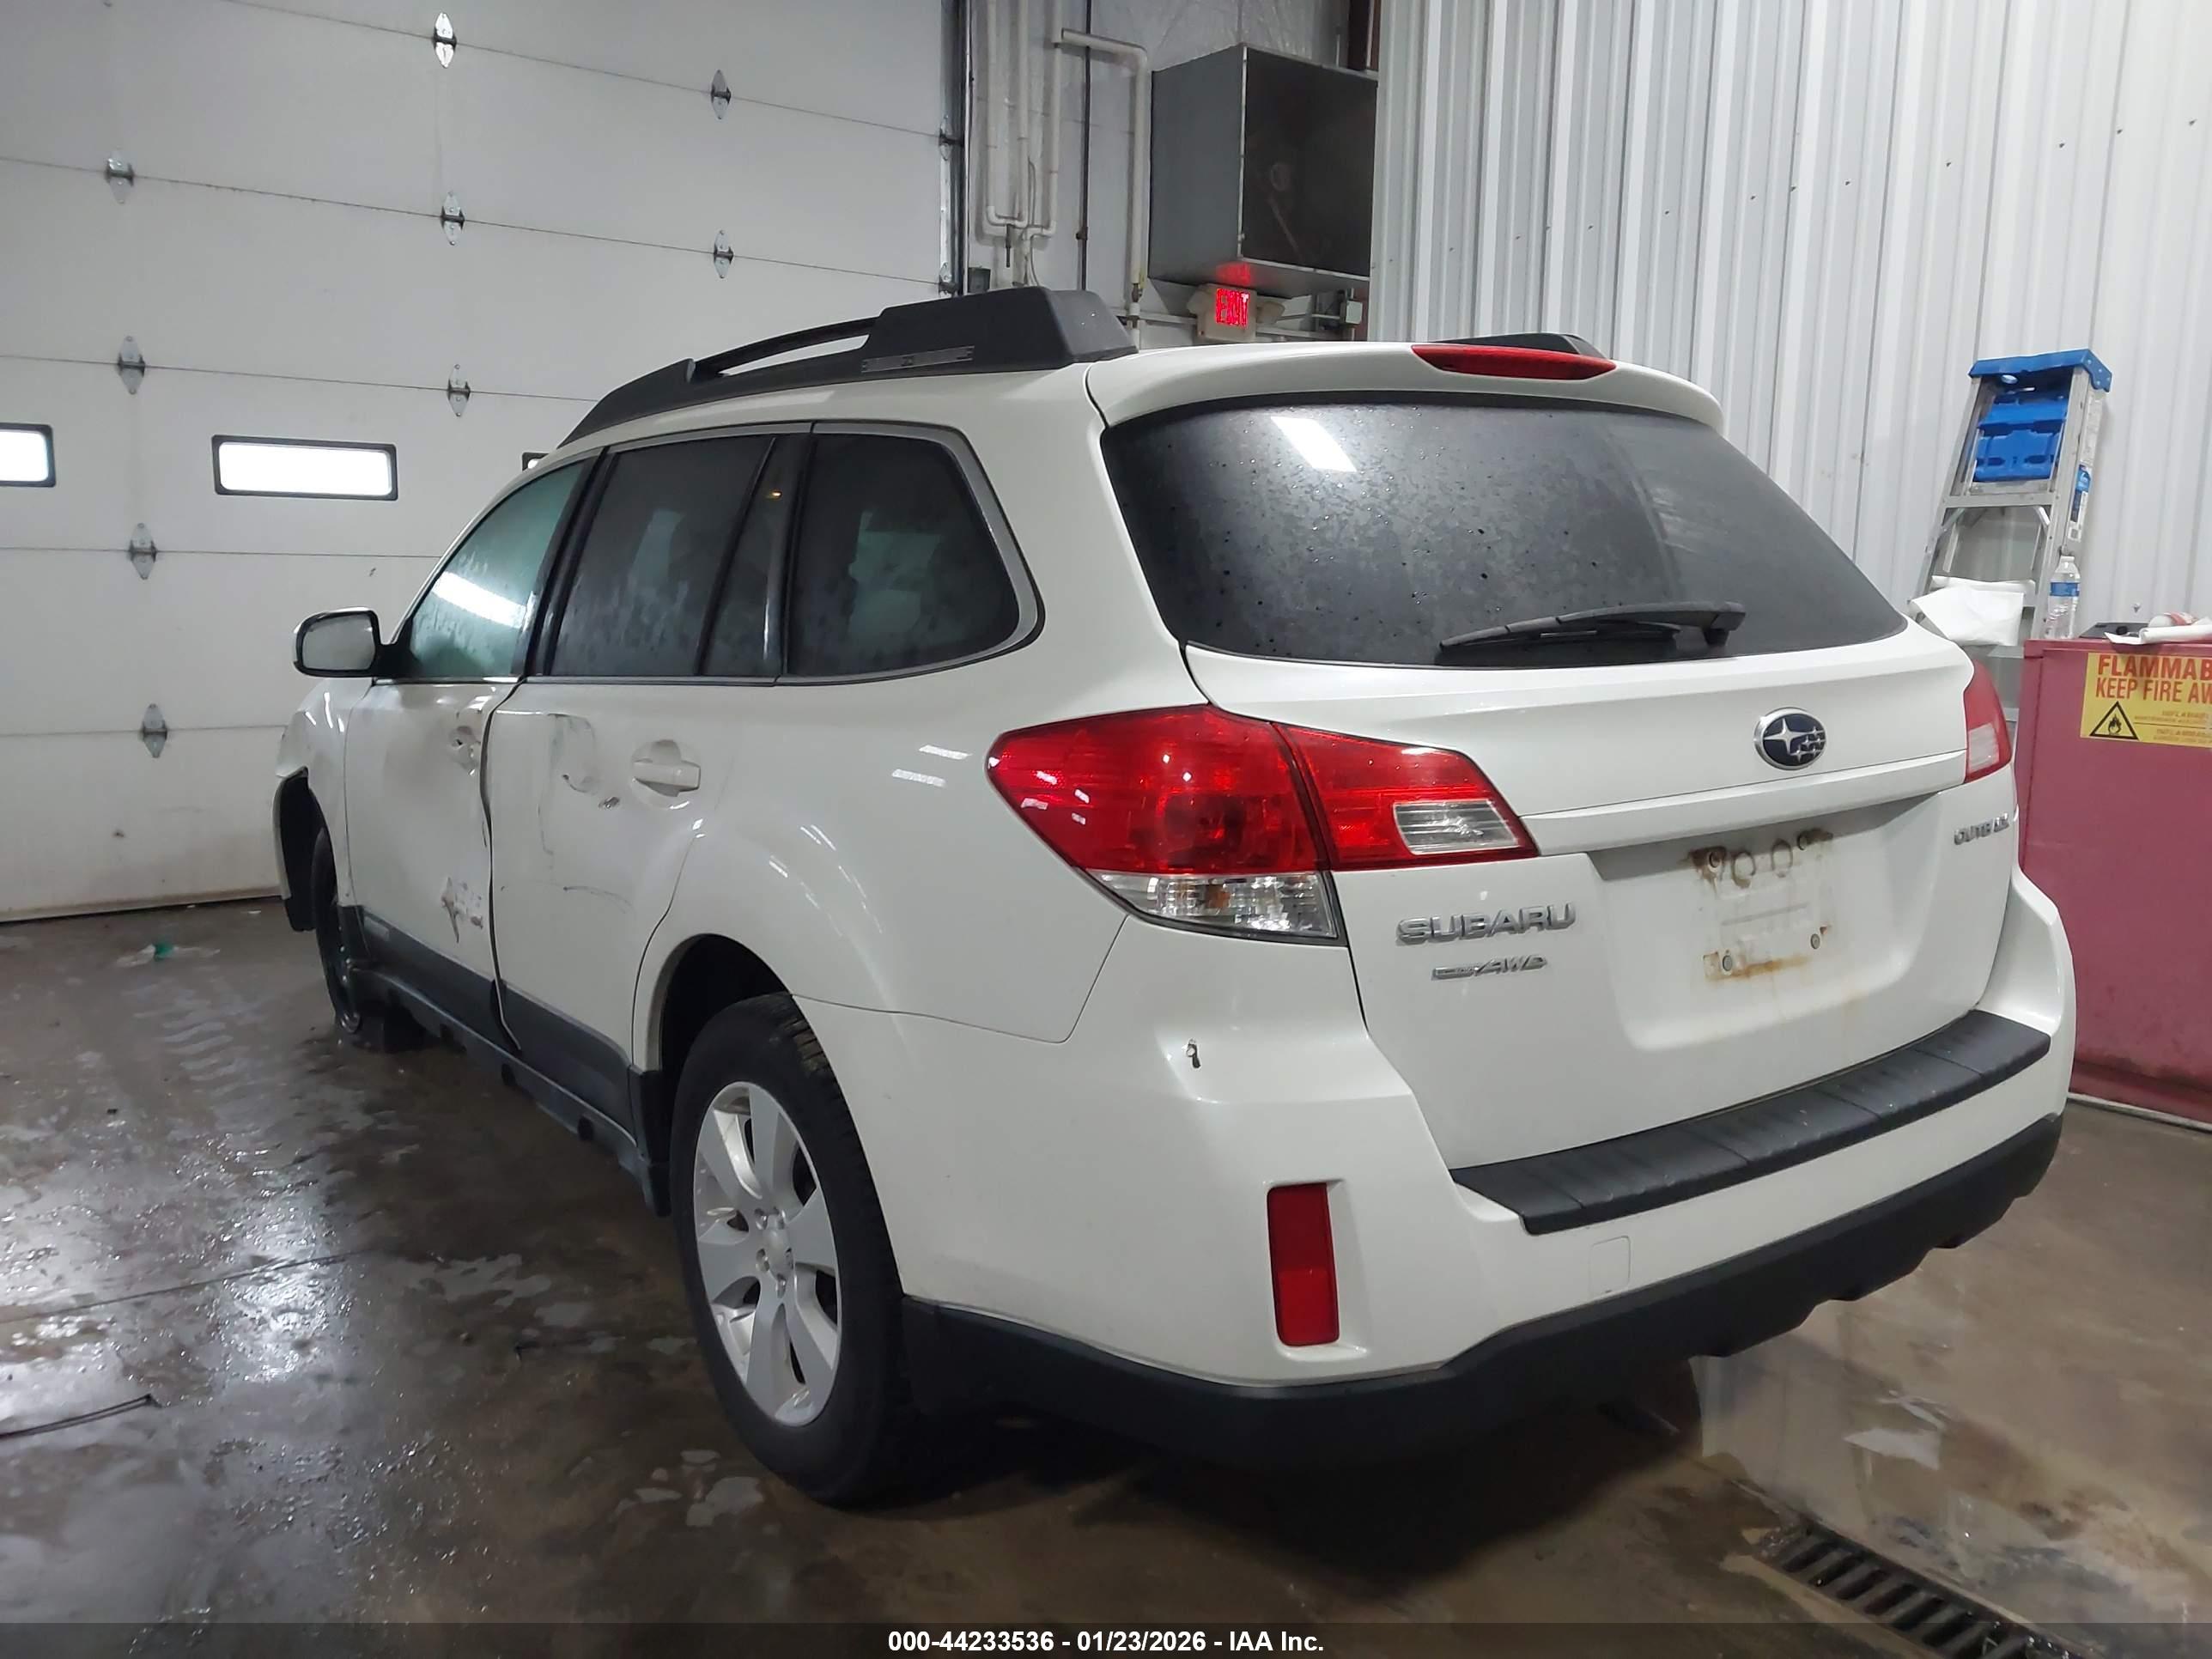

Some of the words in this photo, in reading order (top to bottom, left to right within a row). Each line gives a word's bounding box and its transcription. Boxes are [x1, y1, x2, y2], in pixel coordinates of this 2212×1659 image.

[1216, 289, 1249, 327] EXIT
[2098, 655, 2212, 681] FLAMMAB
[2095, 678, 2138, 700] KEEP
[2142, 680, 2184, 702] FIRE
[1396, 903, 1575, 945] SUBARU
[1475, 954, 1547, 976] AWD
